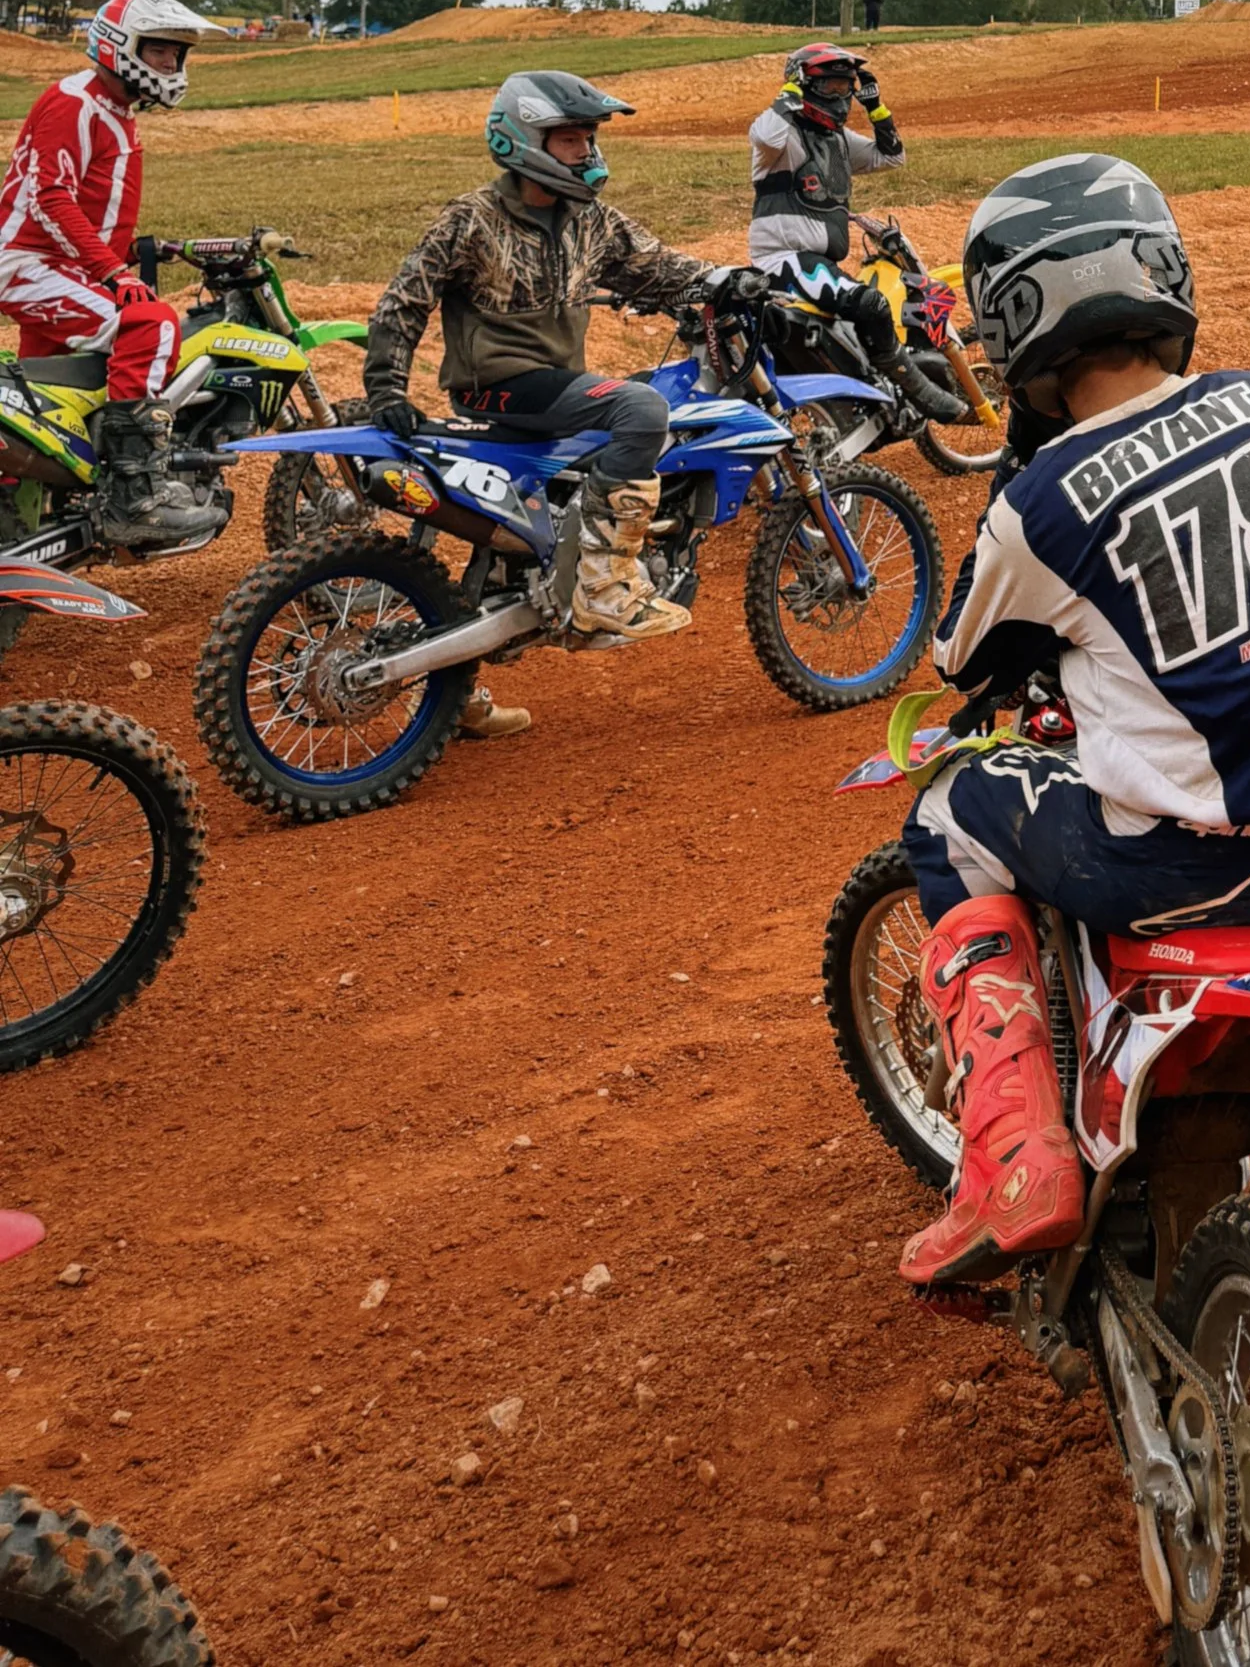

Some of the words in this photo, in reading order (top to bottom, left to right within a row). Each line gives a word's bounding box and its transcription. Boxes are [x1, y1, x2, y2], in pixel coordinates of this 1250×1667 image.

[1072, 262, 1102, 280] DOT
[439, 452, 512, 502] 76
[1148, 942, 1196, 965] HONDA
